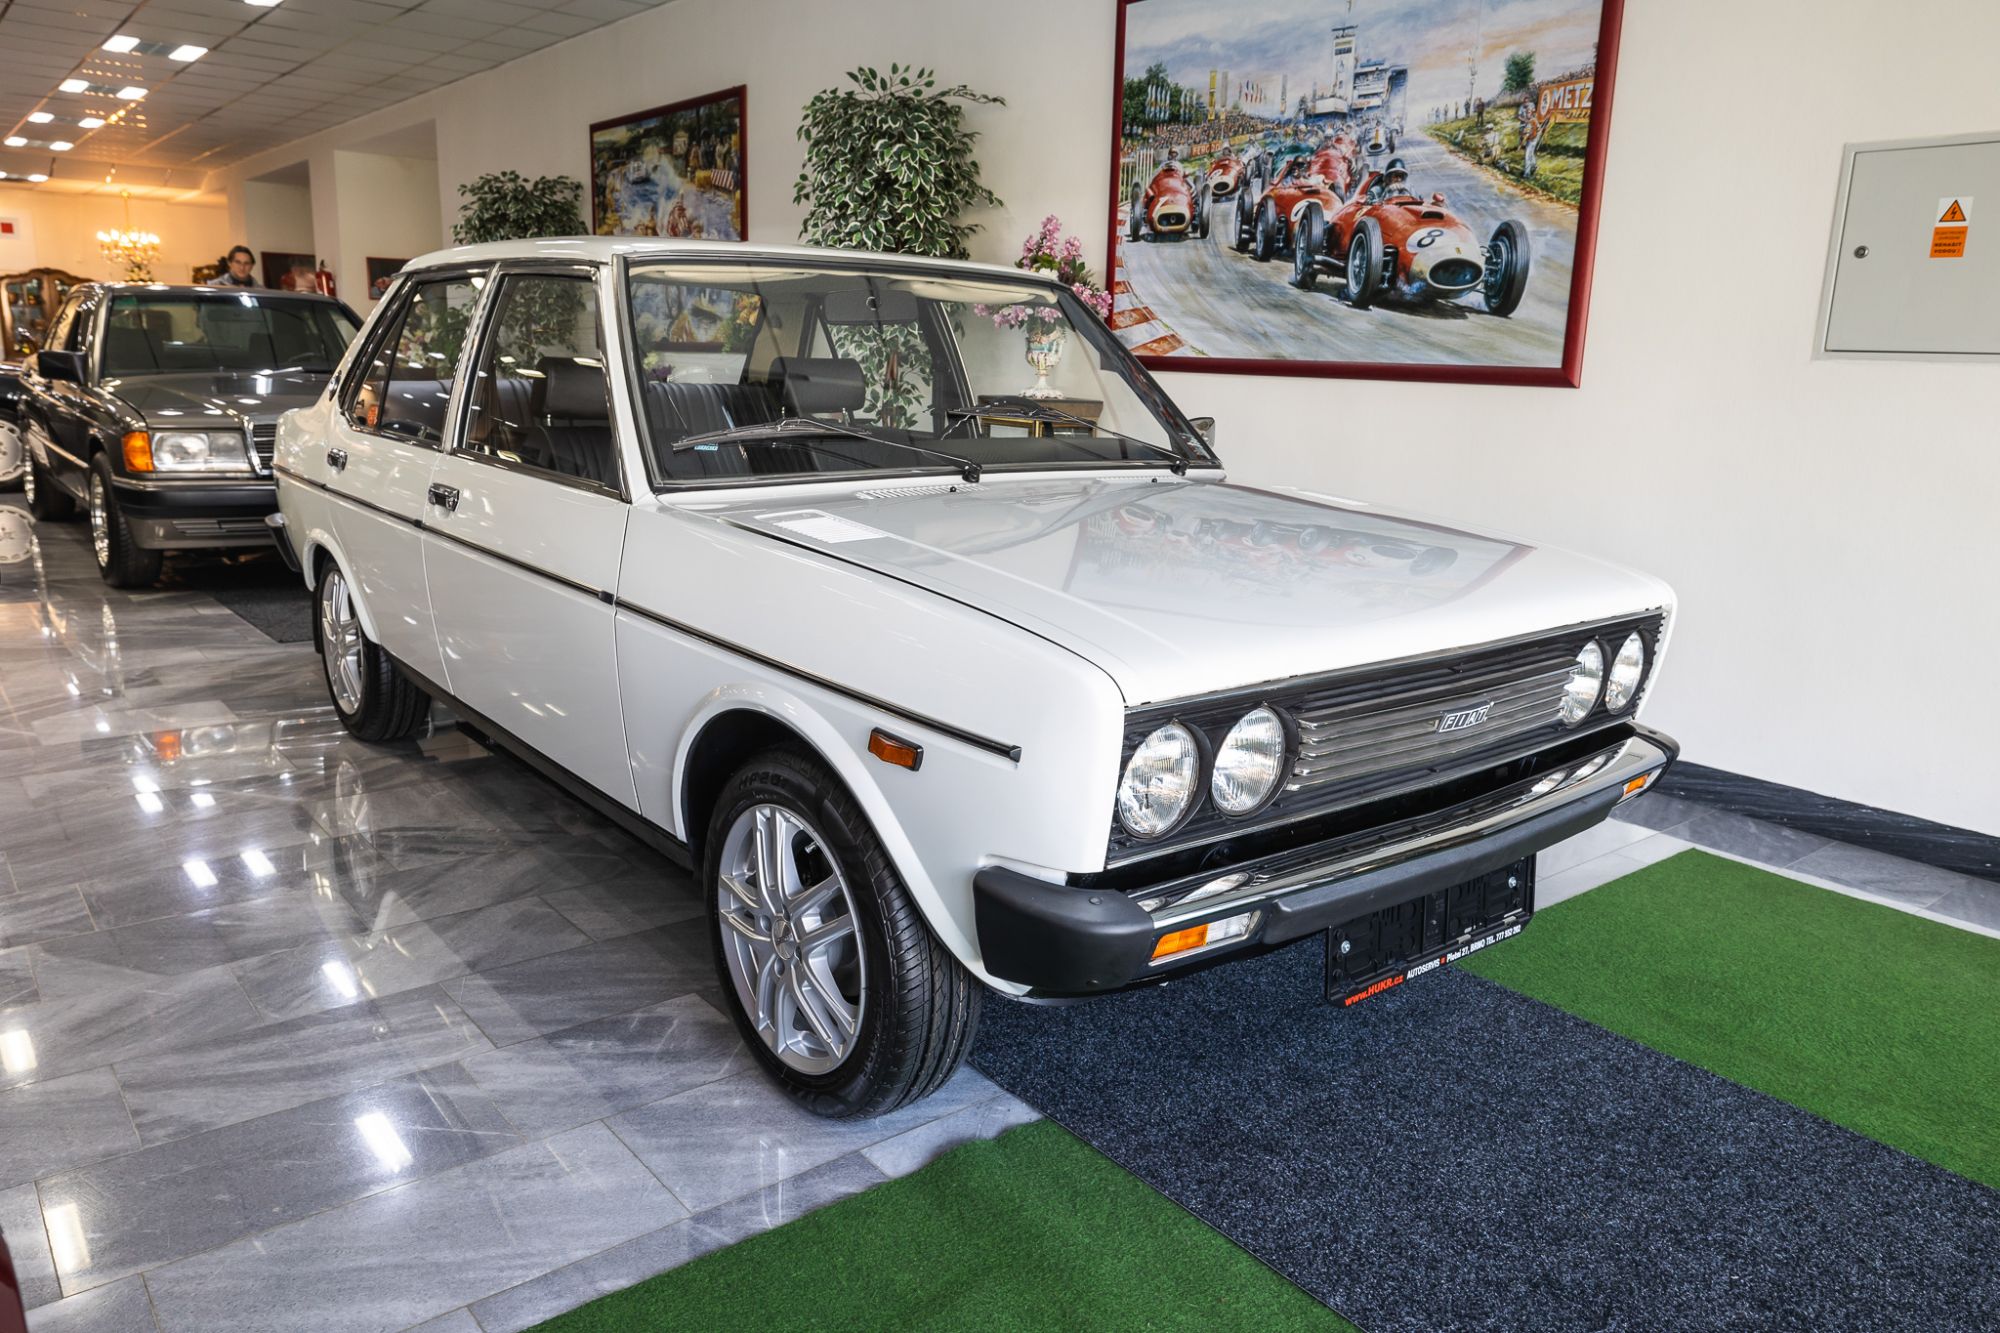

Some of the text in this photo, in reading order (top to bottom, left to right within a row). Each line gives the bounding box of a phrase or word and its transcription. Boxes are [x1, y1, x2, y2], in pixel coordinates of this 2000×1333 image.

[1417, 229, 1444, 248] 8
[1441, 706, 1489, 731] FIAT
[1345, 975, 1404, 1006] www.HUKR.cz
[1406, 958, 1440, 980] AUTOSERVIS
[1470, 939, 1485, 952] BRNO
